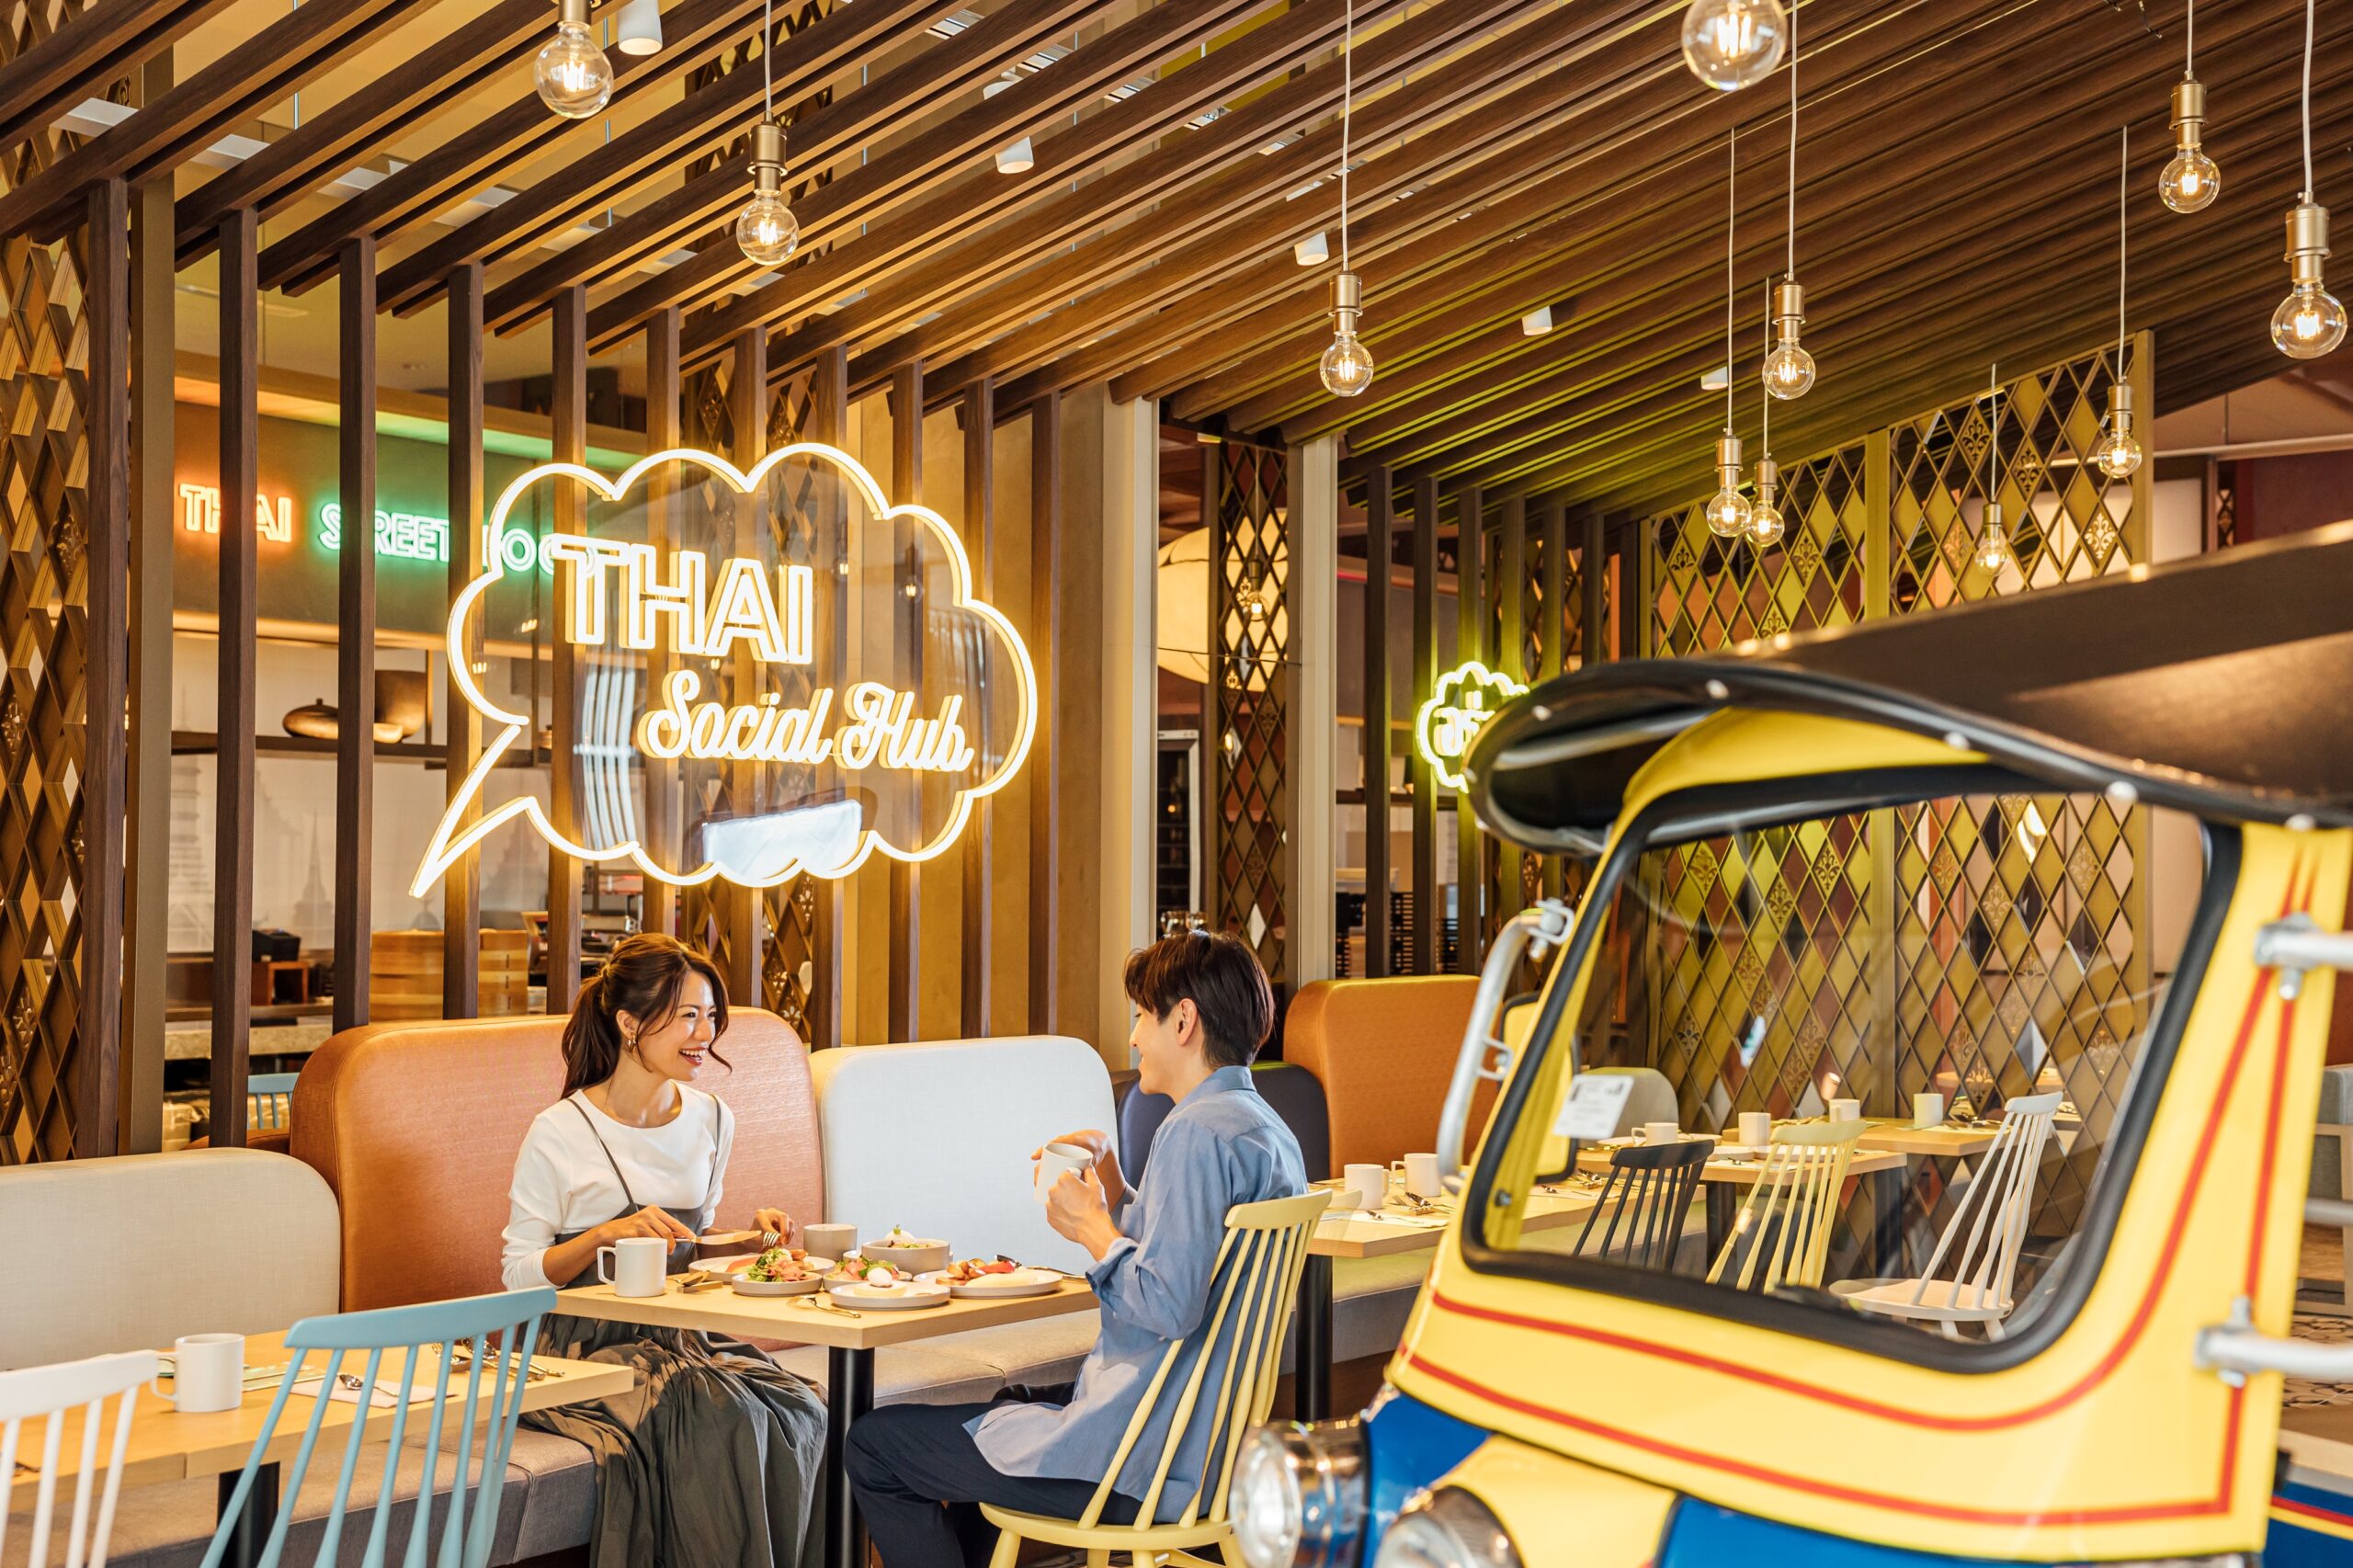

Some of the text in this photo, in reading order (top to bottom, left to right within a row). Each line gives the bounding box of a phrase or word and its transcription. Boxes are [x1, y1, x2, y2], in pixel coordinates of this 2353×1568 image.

[319, 503, 449, 562] SREET
[551, 533, 813, 665] THAI
[638, 670, 975, 772] Social Hub
